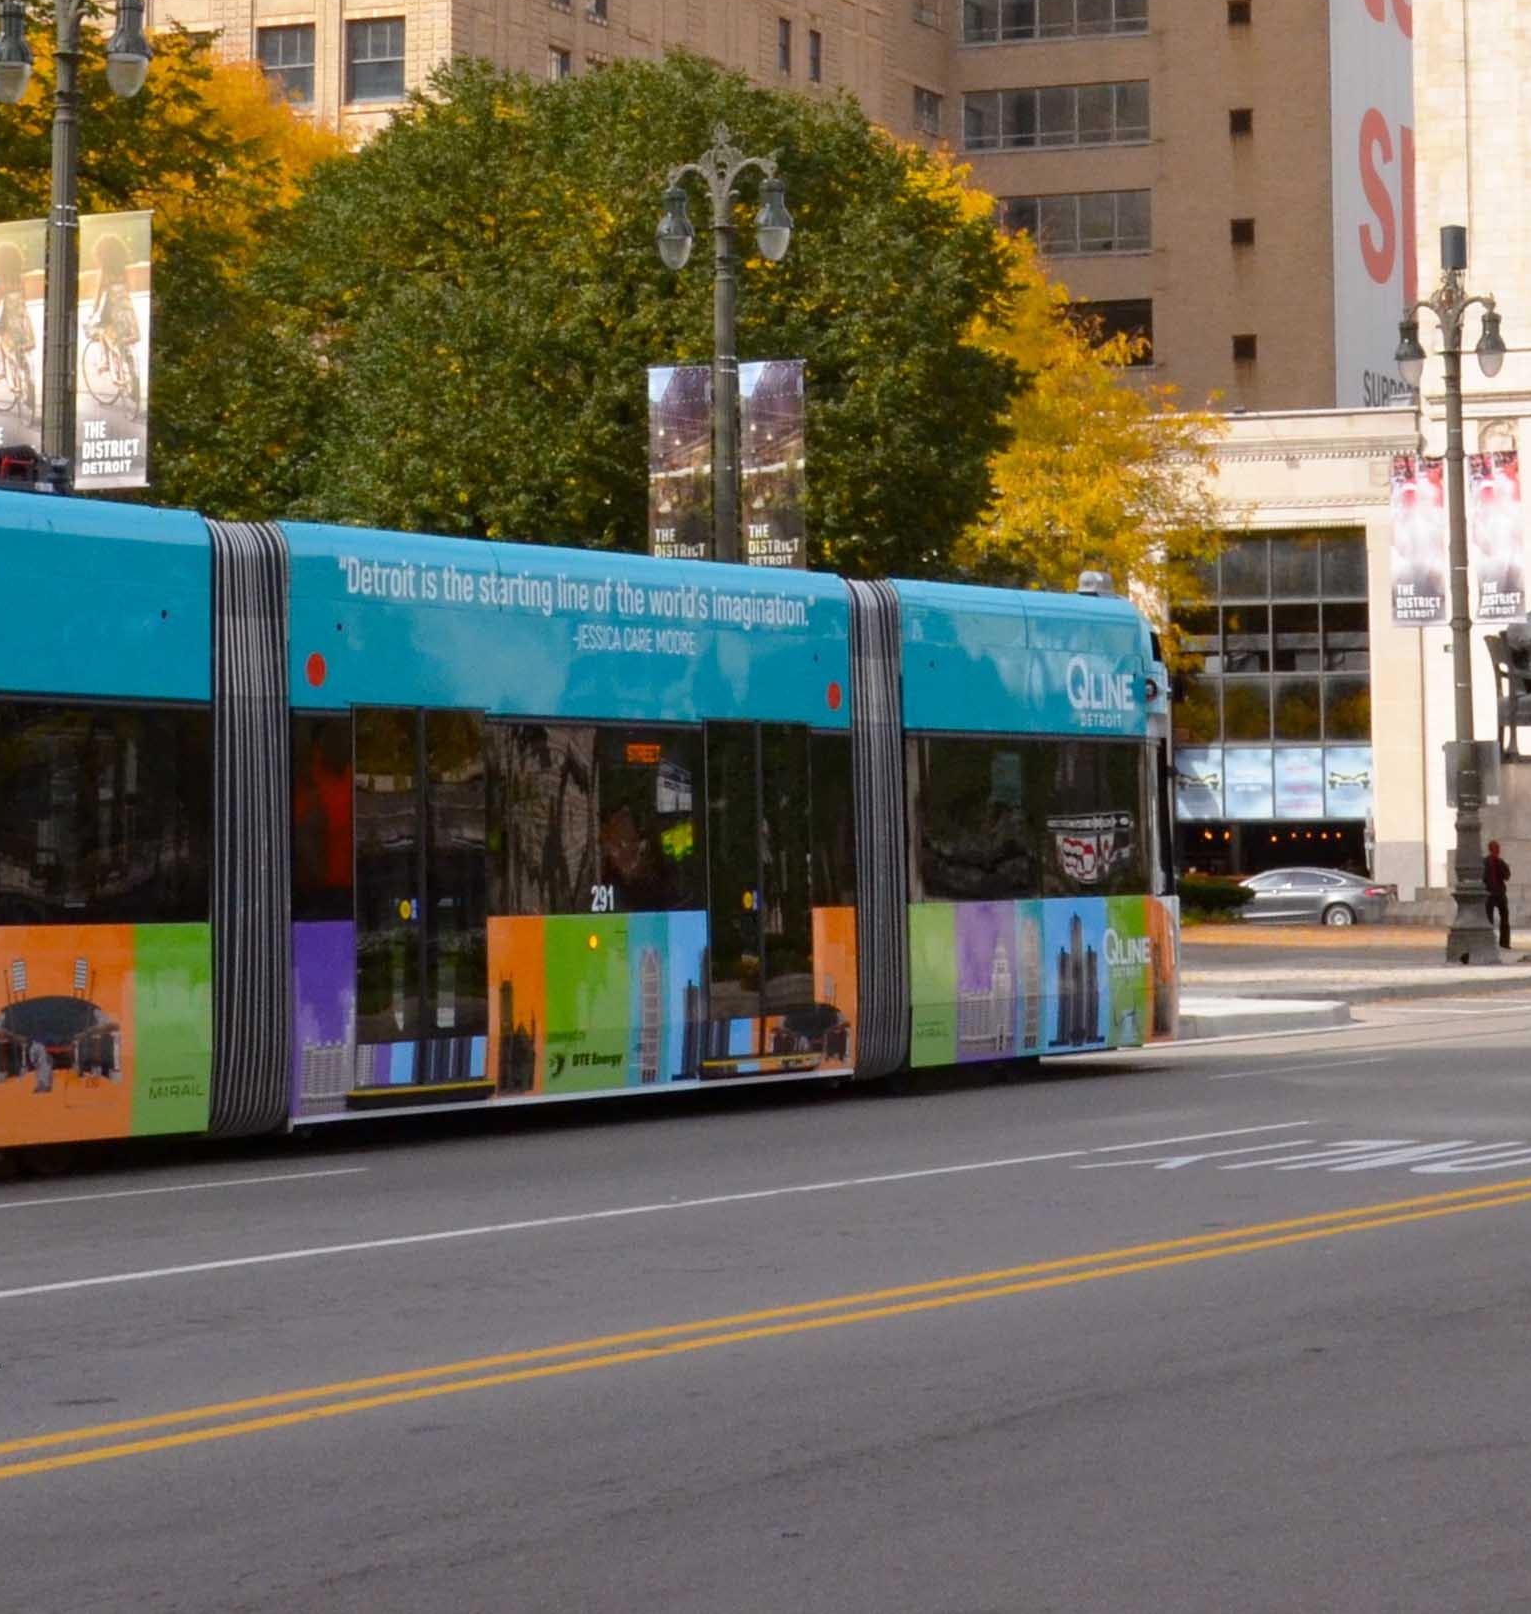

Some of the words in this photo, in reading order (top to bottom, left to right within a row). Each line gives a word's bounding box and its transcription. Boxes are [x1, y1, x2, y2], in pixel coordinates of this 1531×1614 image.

[83, 420, 107, 439] THE
[82, 438, 140, 460] DISTRICT
[81, 459, 133, 475] DETROIT
[654, 527, 677, 542] THE
[748, 523, 770, 538] THE
[653, 542, 706, 558] DISTRICT
[747, 538, 800, 555] DISTRICT
[748, 554, 793, 567] DETROIT
[421, 561, 438, 600] is
[442, 563, 474, 603] the
[479, 570, 553, 617] starting
[557, 572, 589, 611] line
[594, 577, 612, 613] of
[616, 579, 645, 616] the
[649, 585, 708, 620] world's
[1396, 584, 1414, 596] THE
[1396, 596, 1441, 609] DISTRICT
[624, 627, 654, 653] CARE
[656, 630, 697, 656] MOORE
[1066, 654, 1135, 711] QLINE
[1080, 713, 1122, 727] DETROIT
[590, 884, 615, 912] 291
[1103, 928, 1152, 966] QLINE
